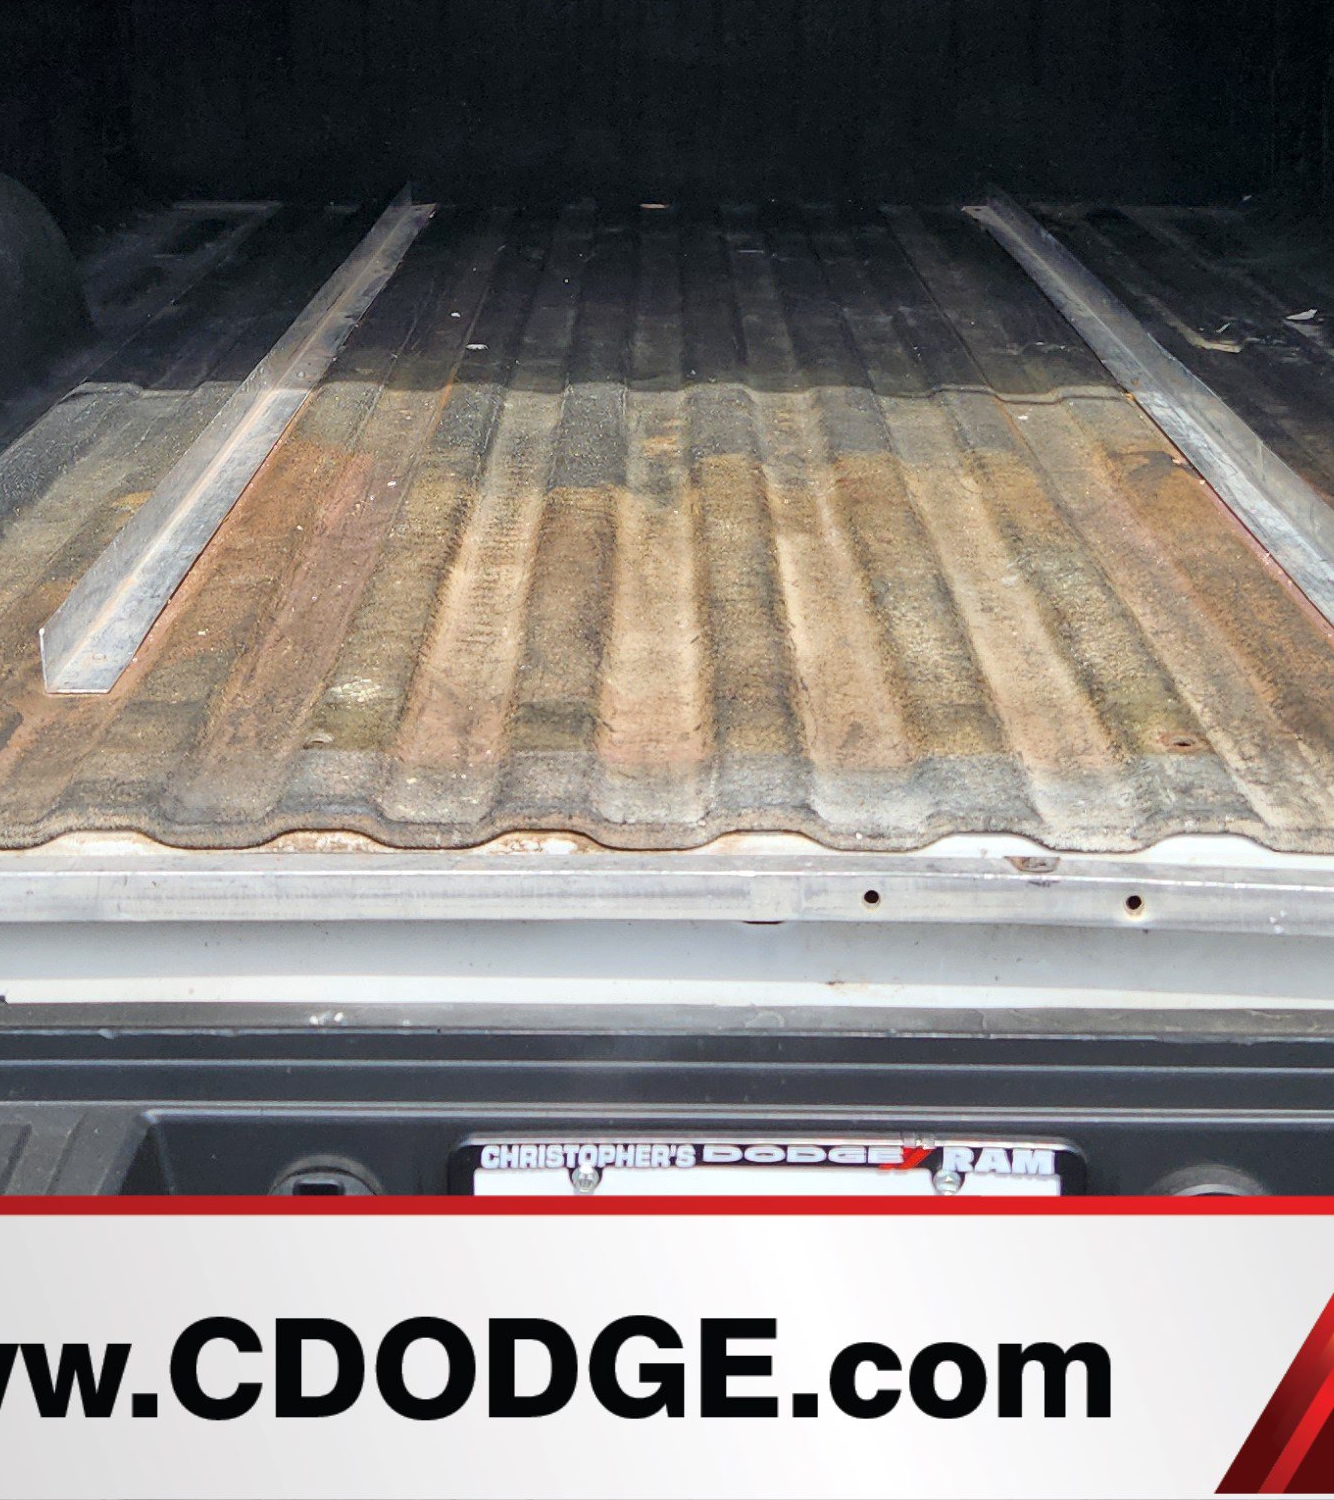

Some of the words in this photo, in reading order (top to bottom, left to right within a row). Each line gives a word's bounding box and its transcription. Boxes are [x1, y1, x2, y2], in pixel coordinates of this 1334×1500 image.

[480, 1144, 697, 1170] CHRISTOPHER'S
[702, 1145, 906, 1165] DODGE
[941, 1146, 1057, 1176] RAM
